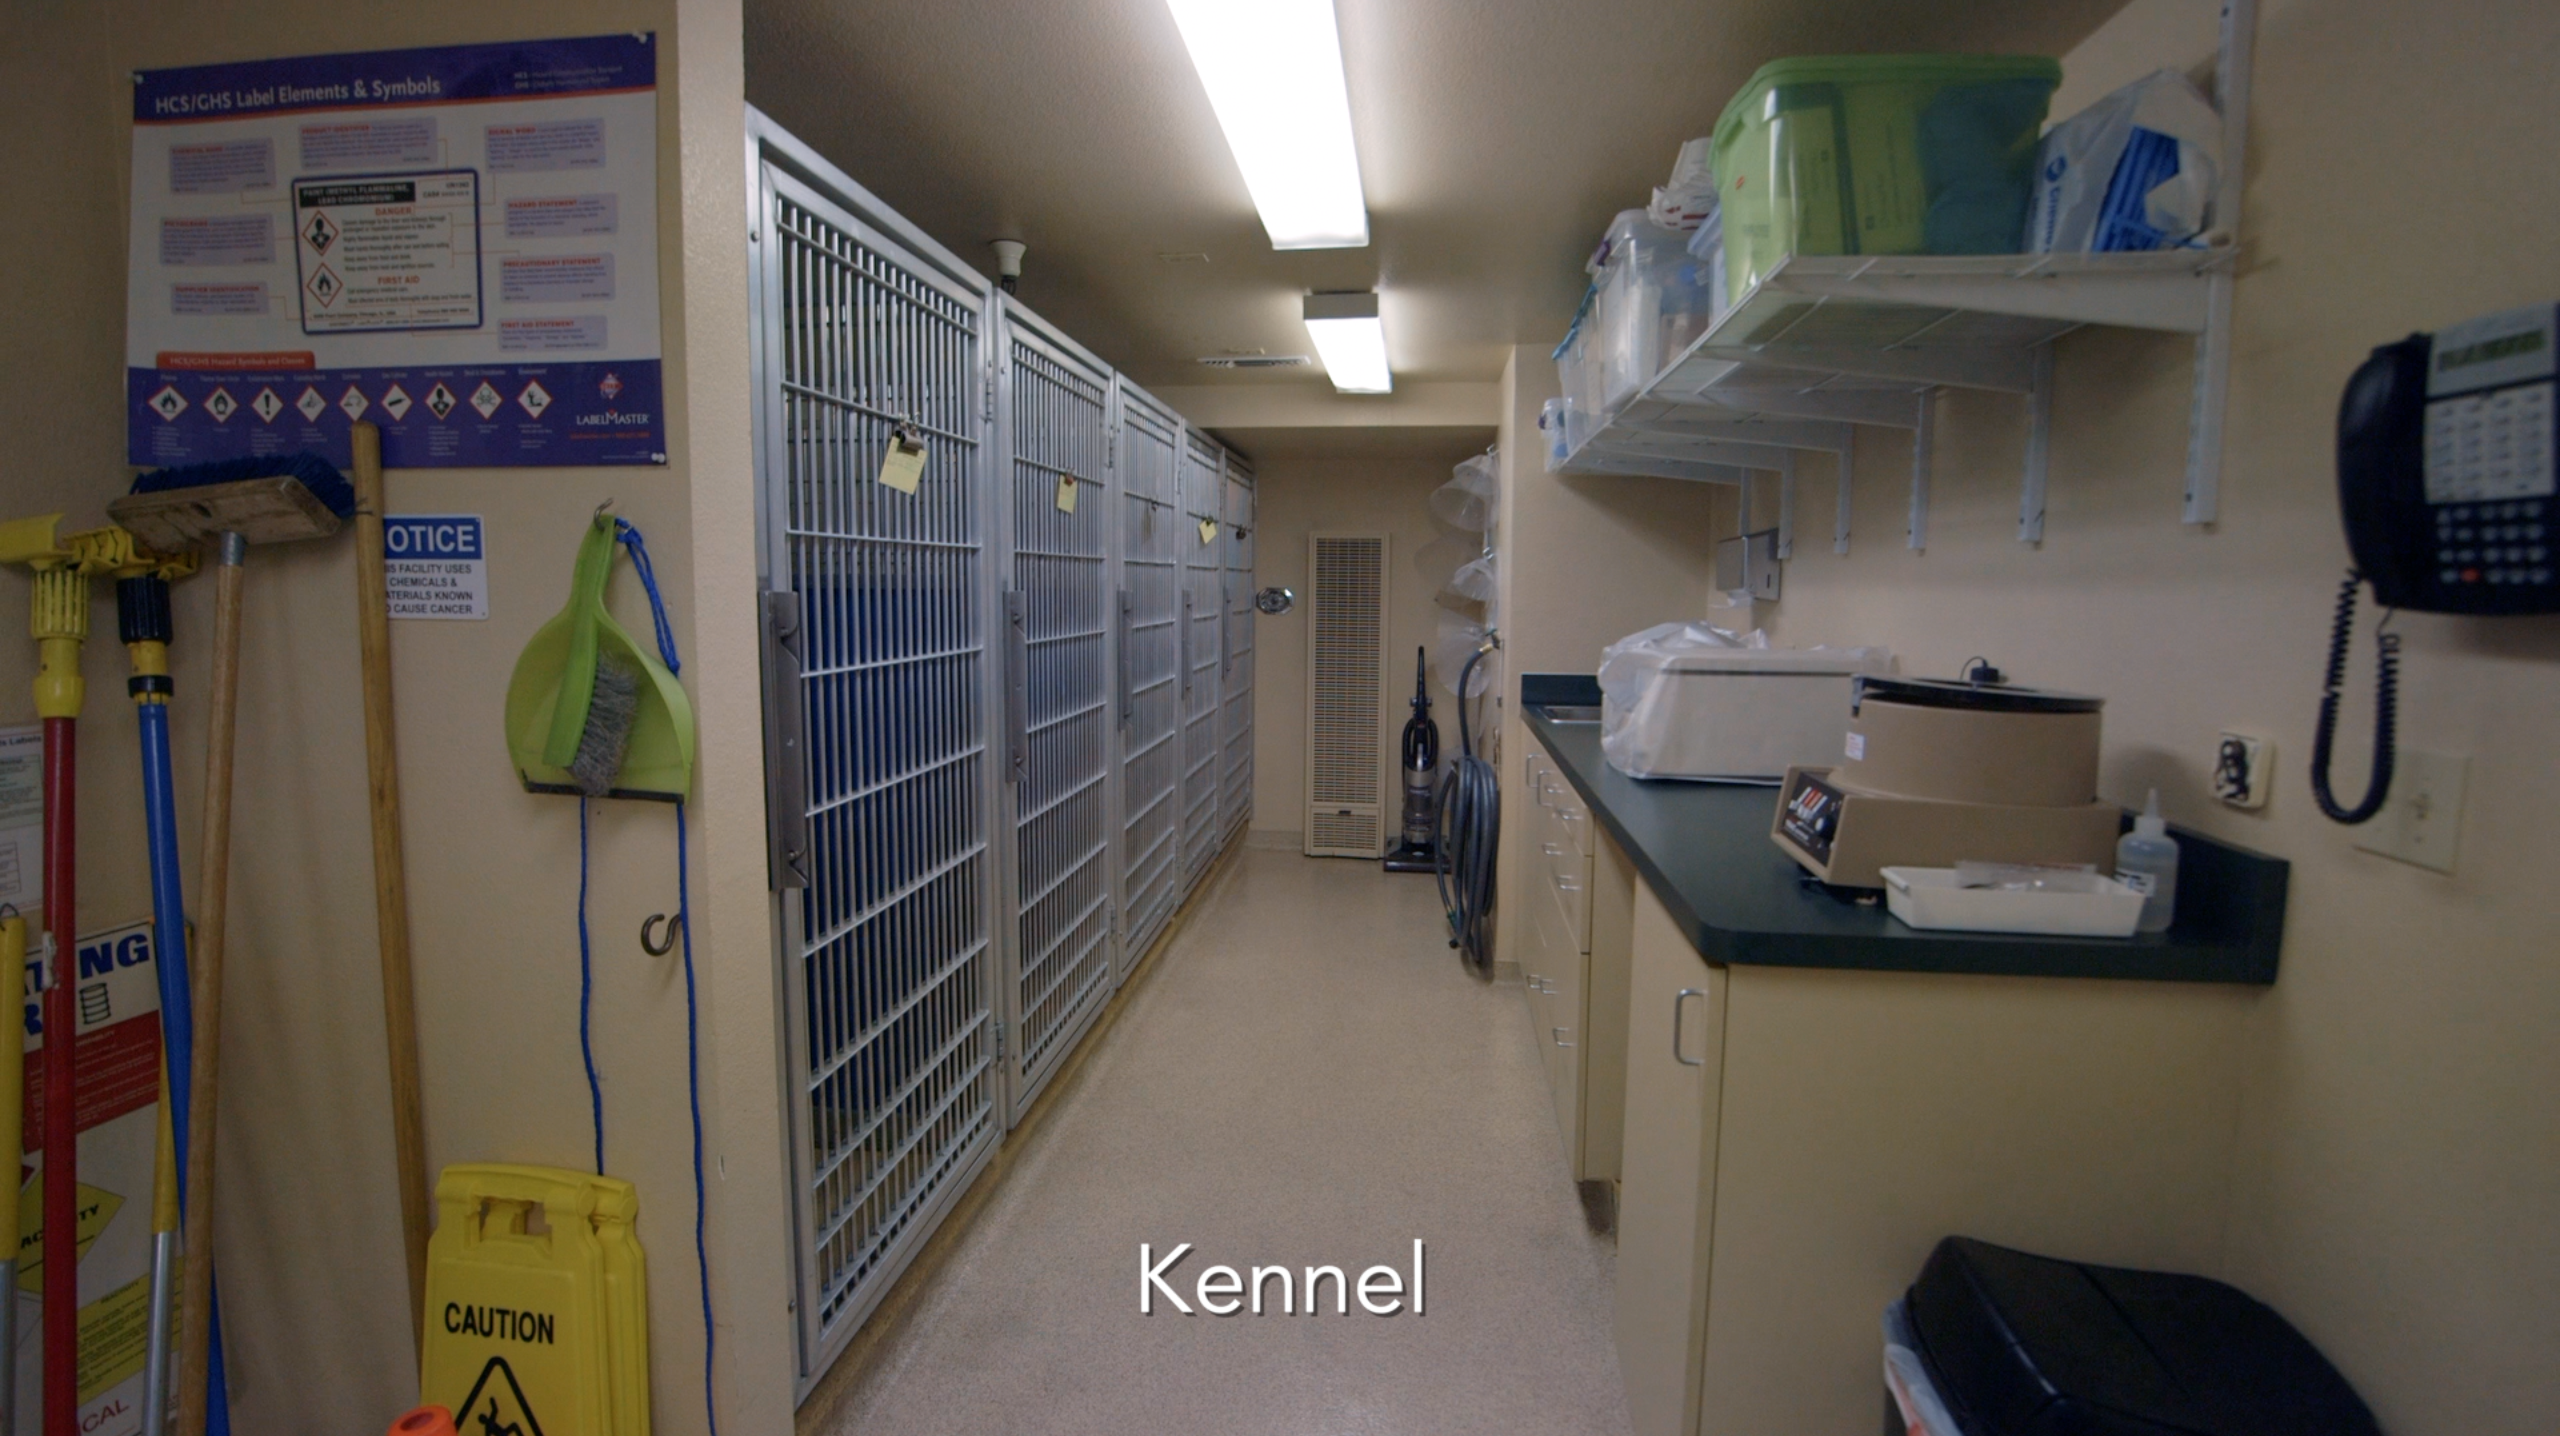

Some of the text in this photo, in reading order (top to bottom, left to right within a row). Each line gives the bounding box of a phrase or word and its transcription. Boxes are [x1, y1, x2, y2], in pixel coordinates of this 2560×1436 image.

[155, 75, 441, 114] HCS/GHS Label Elements & Symbols
[538, 200, 577, 208] STATEMENT
[375, 207, 412, 216] DANGER
[377, 275, 420, 285] FIRST AID
[169, 357, 209, 366] HCS/GHS
[210, 357, 236, 366] Hazard
[267, 357, 280, 365] and
[576, 413, 650, 426] LABELMASTER
[386, 524, 476, 553] OTICE
[399, 564, 442, 574] FACILITY
[444, 564, 472, 574] USES
[389, 577, 457, 588] CHEMICALS &
[386, 590, 473, 601] ATERIALS KNOWN
[394, 604, 428, 614] CAUSE
[430, 604, 473, 614] CANCER
[10, 734, 42, 747] Labels
[444, 1302, 554, 1345] CAUTION
